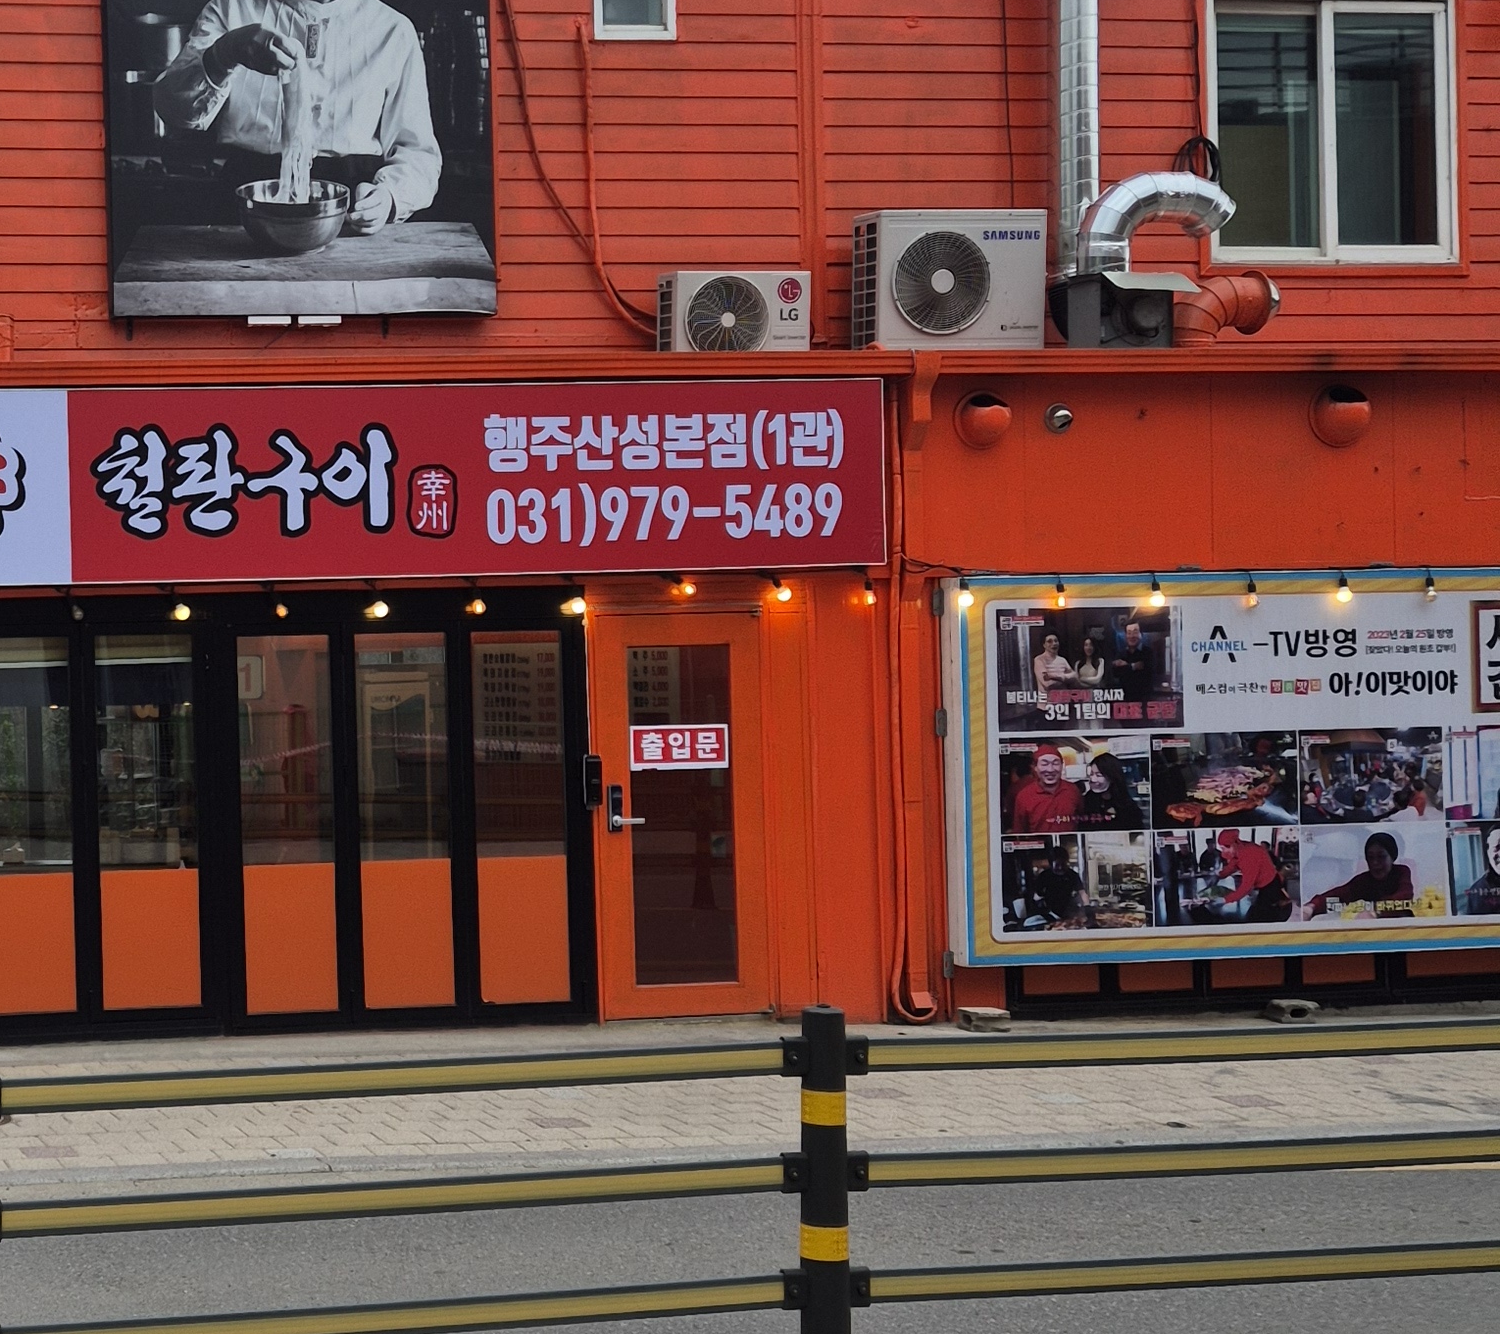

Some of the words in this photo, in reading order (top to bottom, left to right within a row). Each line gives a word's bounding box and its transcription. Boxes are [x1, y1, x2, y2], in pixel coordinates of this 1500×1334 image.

[982, 229, 1041, 242] SAMSUNG
[780, 308, 799, 321] LG
[483, 409, 844, 473] 행주산성본점(1관)
[94, 426, 395, 537] 철판구이
[416, 470, 451, 532] 幸州
[486, 483, 844, 547] 031)979-5489
[1191, 640, 1248, 653] CHANNEL
[1329, 669, 1459, 697] 아!이맛이야
[1044, 703, 1070, 721] 3인
[1074, 703, 1111, 720] 1팀의
[640, 731, 720, 761] 출입문
